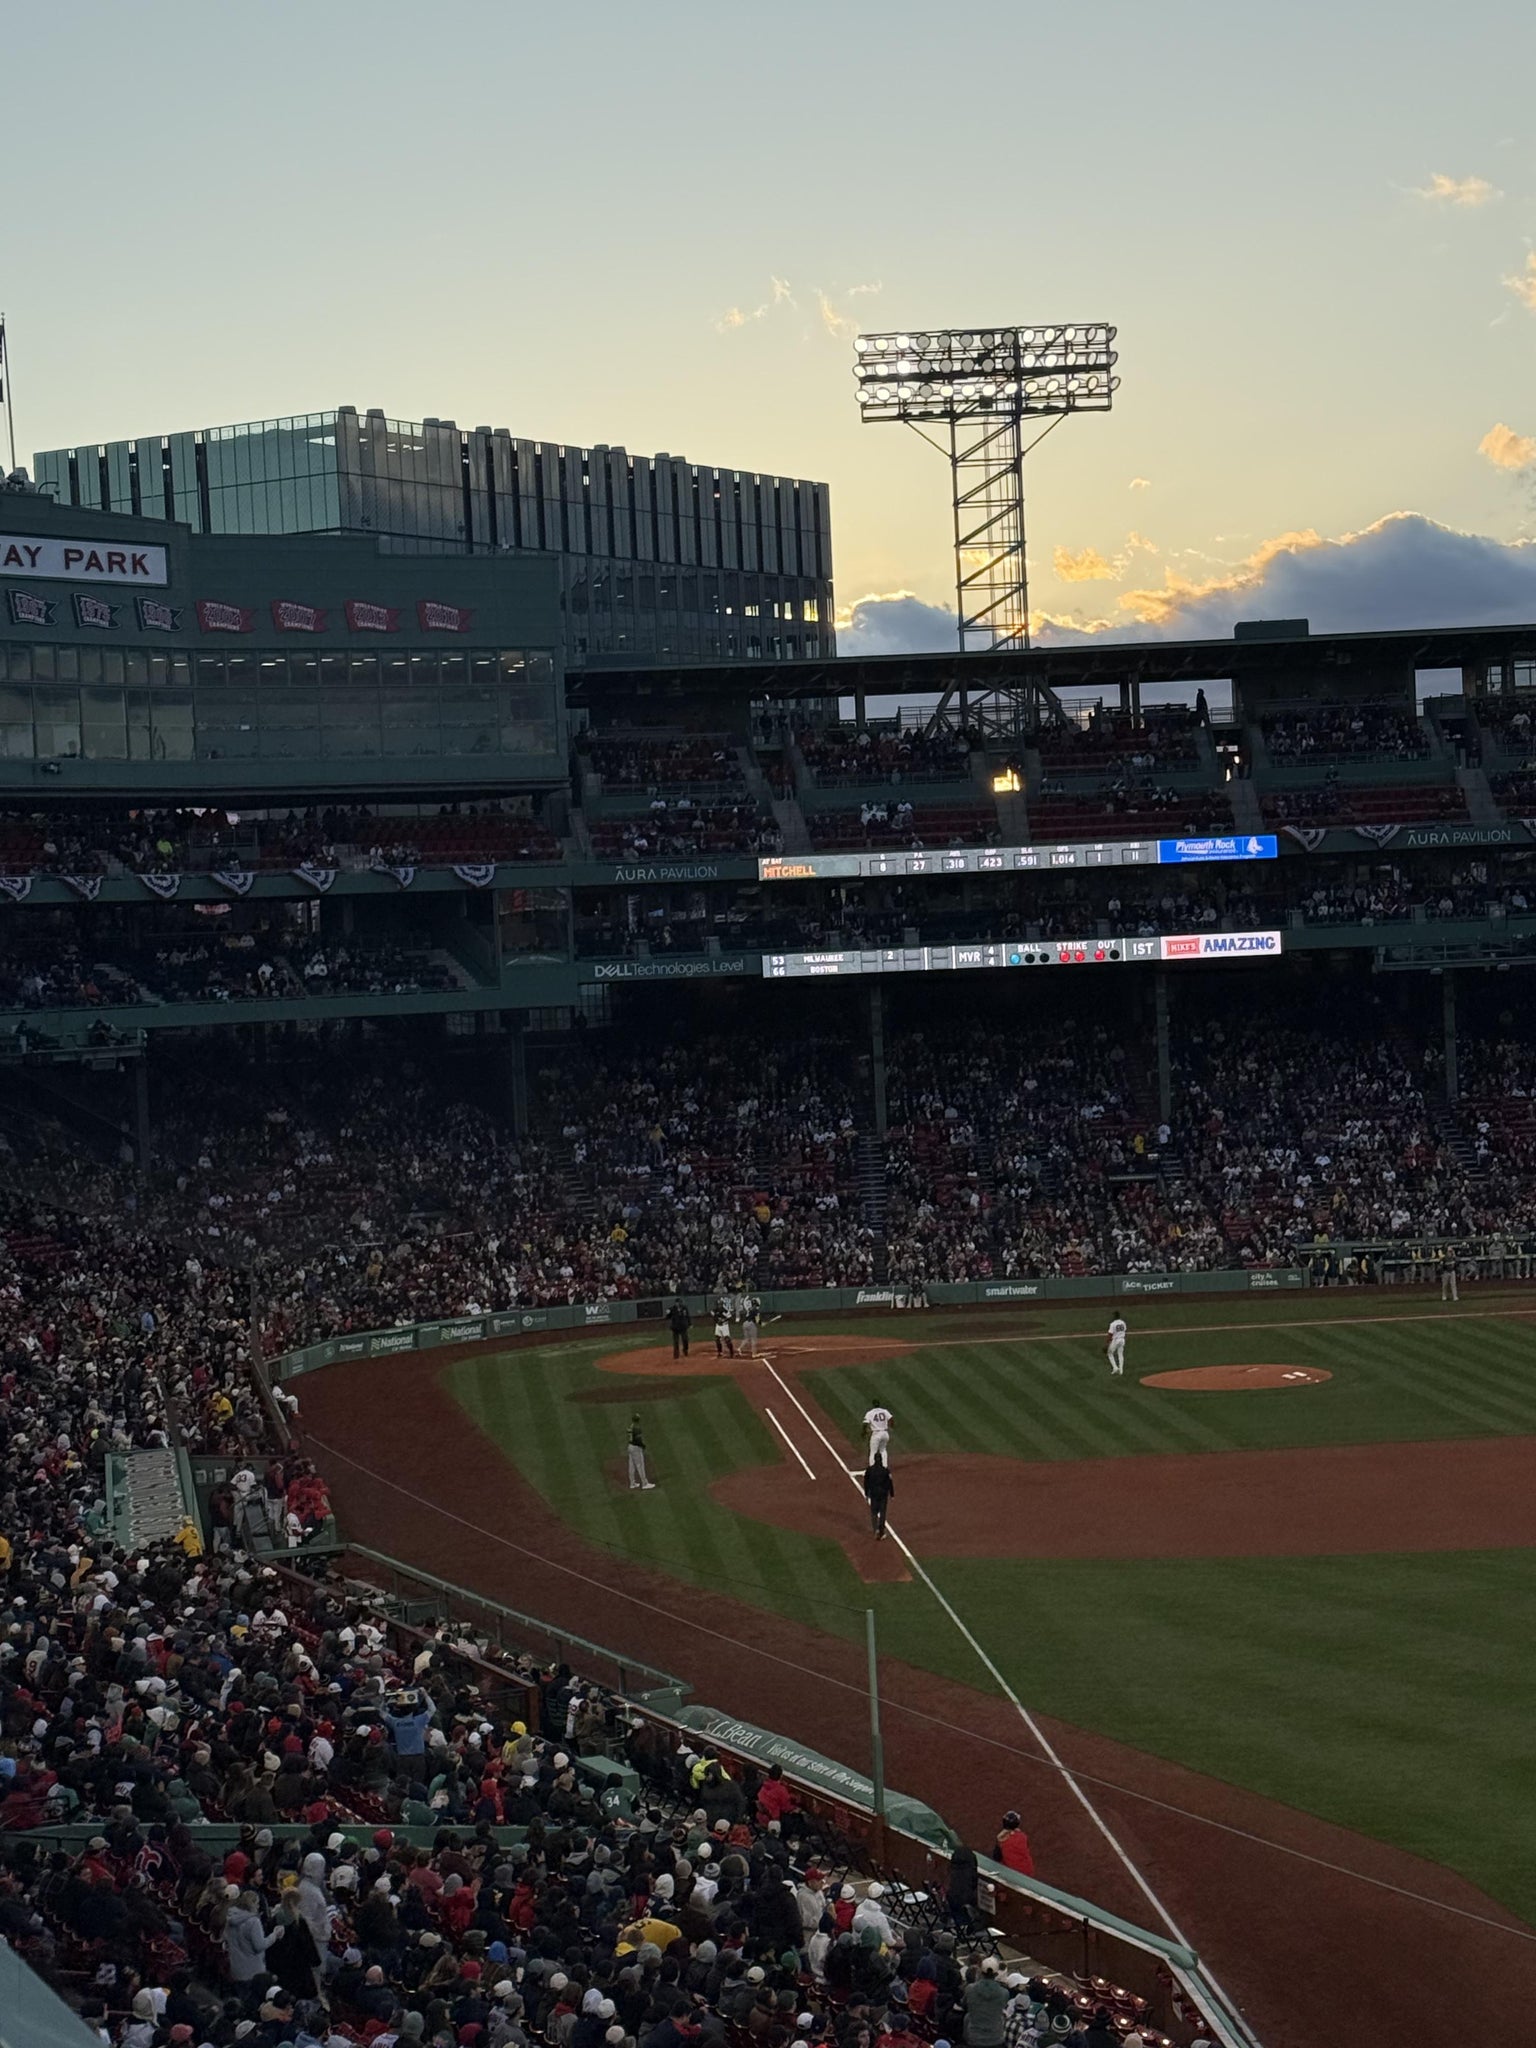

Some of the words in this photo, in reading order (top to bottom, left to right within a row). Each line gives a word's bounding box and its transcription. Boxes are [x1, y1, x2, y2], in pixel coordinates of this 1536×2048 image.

[0, 544, 42, 567] AY
[64, 548, 150, 575] PARK
[1453, 830, 1511, 843] PAVILION
[1176, 840, 1214, 853] Plymouth
[1215, 839, 1236, 849] Rock
[981, 858, 1002, 867] .423
[1018, 856, 1037, 865] .591
[1052, 855, 1075, 864] 1.014
[763, 865, 816, 877] MITCHELL
[912, 861, 925, 871] 27
[660, 866, 717, 879] PAVILION
[988, 946, 994, 954] 4
[1018, 944, 1042, 953] BALL
[1057, 941, 1087, 951] STRIKE
[1098, 940, 1116, 950] OUT
[1203, 936, 1275, 953] AMAZING
[772, 956, 784, 965] 53
[803, 954, 844, 963] MILWAUKEE
[887, 951, 893, 959] 2
[958, 951, 981, 963] MVR
[712, 959, 744, 972] Level
[988, 957, 995, 965] 4
[772, 966, 785, 976] 66
[810, 965, 838, 974] BOSTON
[985, 1285, 1038, 1297] smartwater
[1143, 1281, 1174, 1291] TICKET
[450, 1323, 482, 1337] National
[381, 1333, 413, 1347] National
[873, 1412, 885, 1422] 40
[606, 1795, 620, 1808] 34
